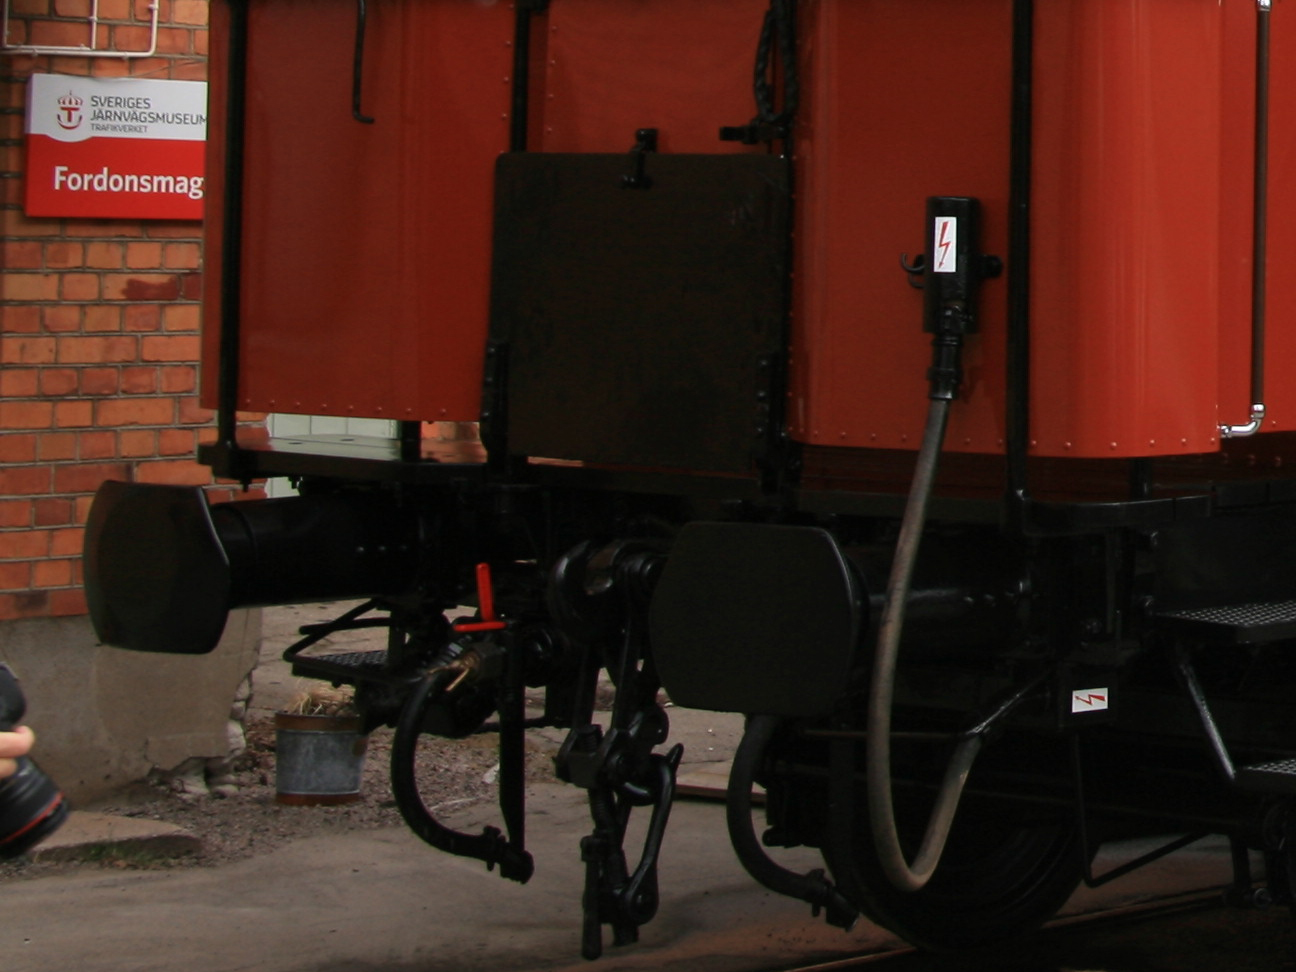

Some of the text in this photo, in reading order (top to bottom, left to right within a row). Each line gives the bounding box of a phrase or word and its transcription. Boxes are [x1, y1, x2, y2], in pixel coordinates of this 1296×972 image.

[91, 95, 151, 109] SVERIGES
[91, 123, 148, 133] TRAFIKVERKET
[54, 165, 204, 199] Fordonsmag
